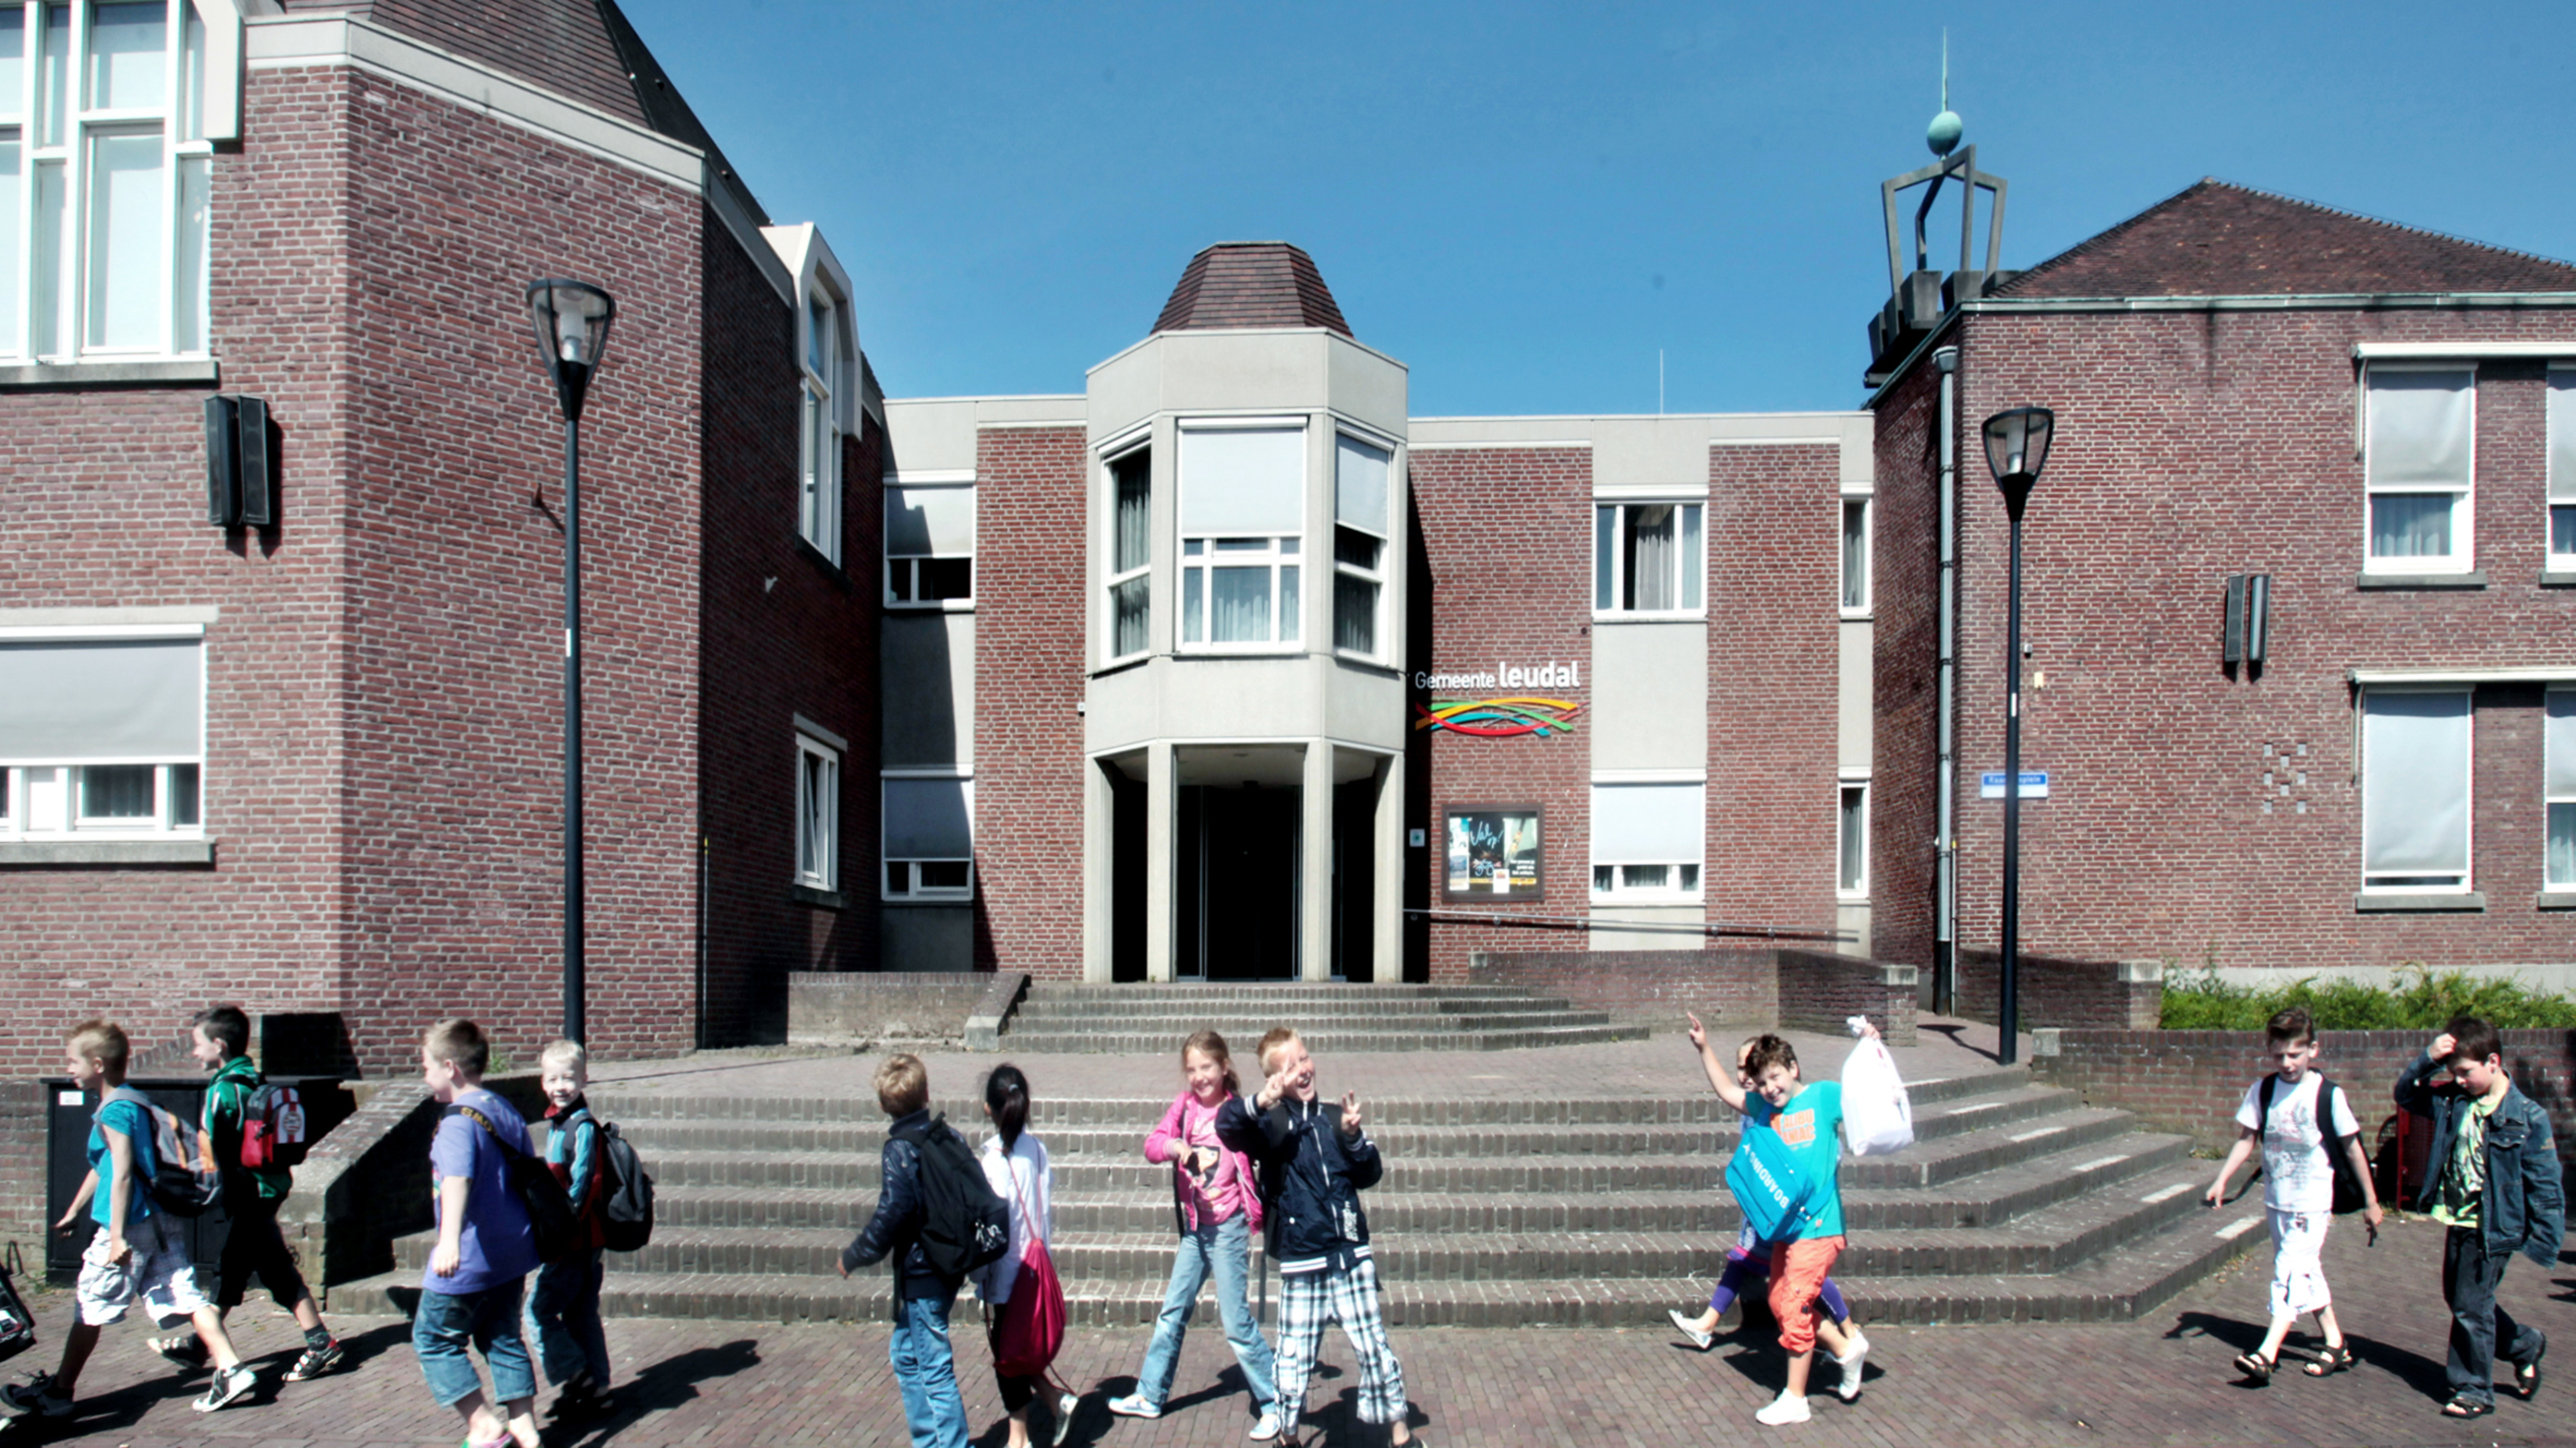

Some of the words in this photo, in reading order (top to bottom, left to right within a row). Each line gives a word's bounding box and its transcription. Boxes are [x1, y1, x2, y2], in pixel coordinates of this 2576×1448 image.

[1415, 671, 1496, 689] Gemeente
[1499, 661, 1580, 688] leudal
[1470, 820, 1493, 846] Val
[1750, 1151, 1790, 1209] BOARDING
